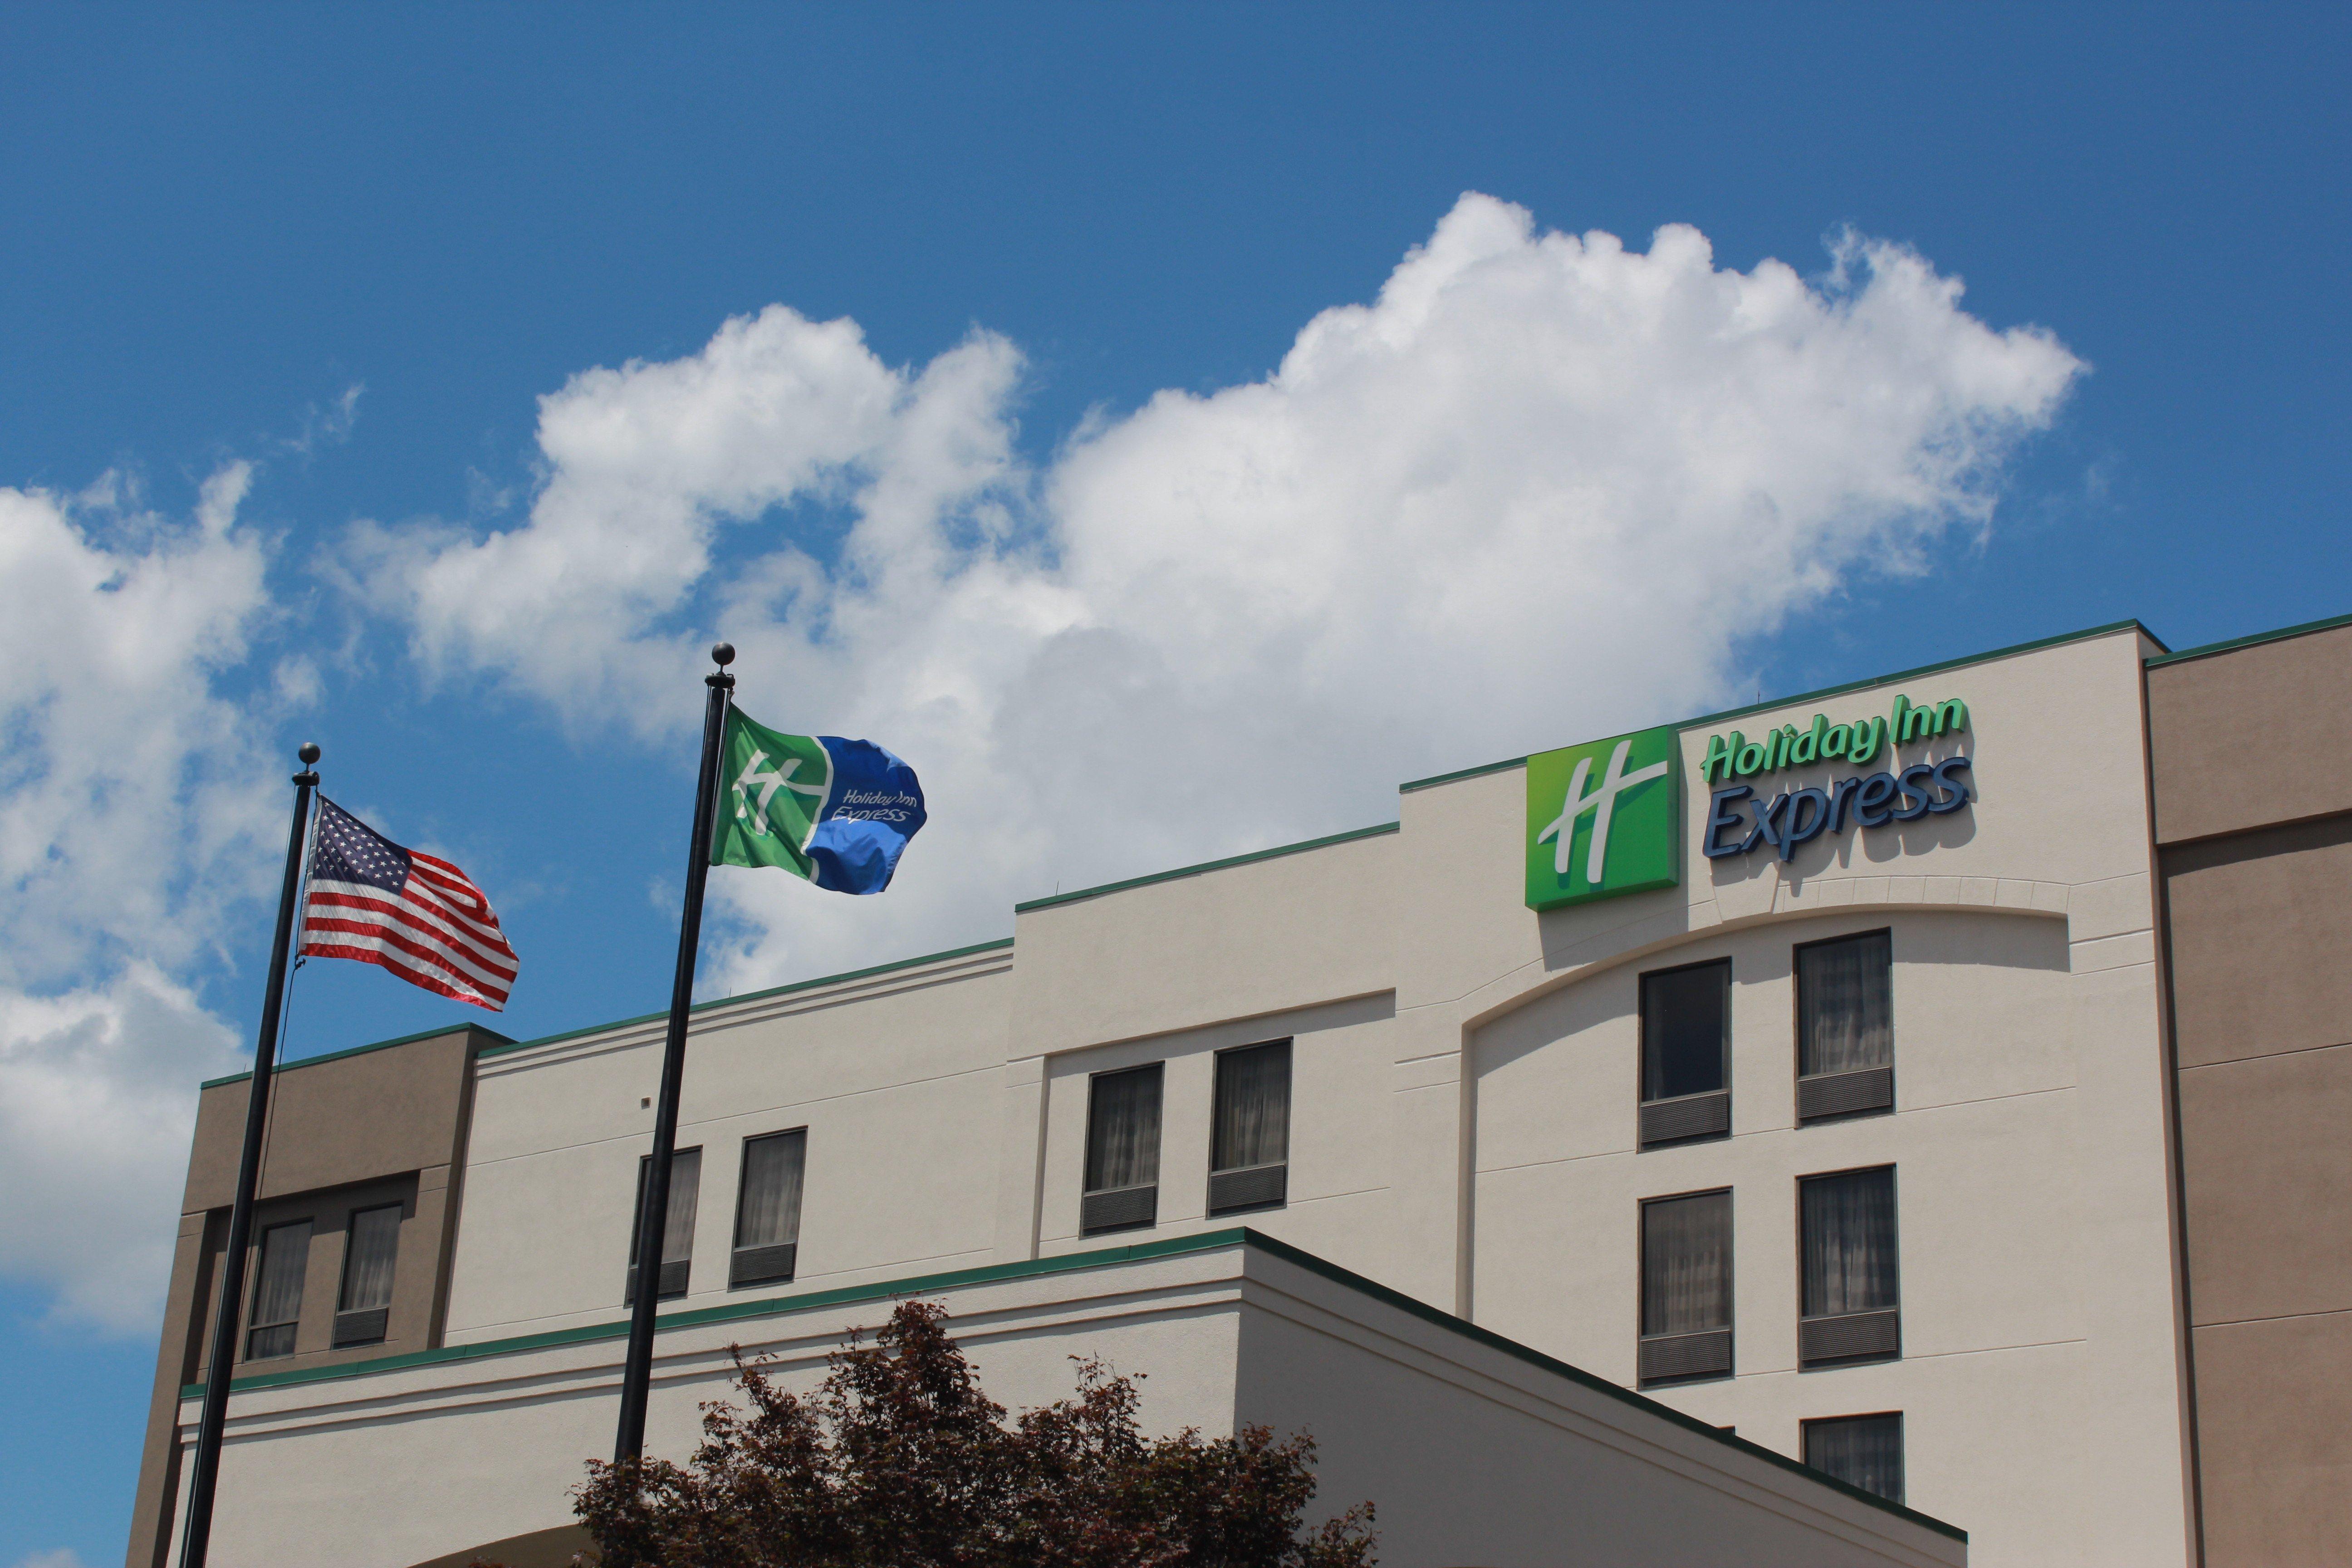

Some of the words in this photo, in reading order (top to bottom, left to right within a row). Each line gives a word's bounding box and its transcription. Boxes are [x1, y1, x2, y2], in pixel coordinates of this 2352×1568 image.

[1700, 714, 1886, 784] Holiday
[1889, 694, 1967, 745] Inn
[831, 806, 911, 824] Express
[843, 789, 897, 805] Holiday
[895, 791, 917, 808] Inn
[1702, 756, 1970, 862] Express
